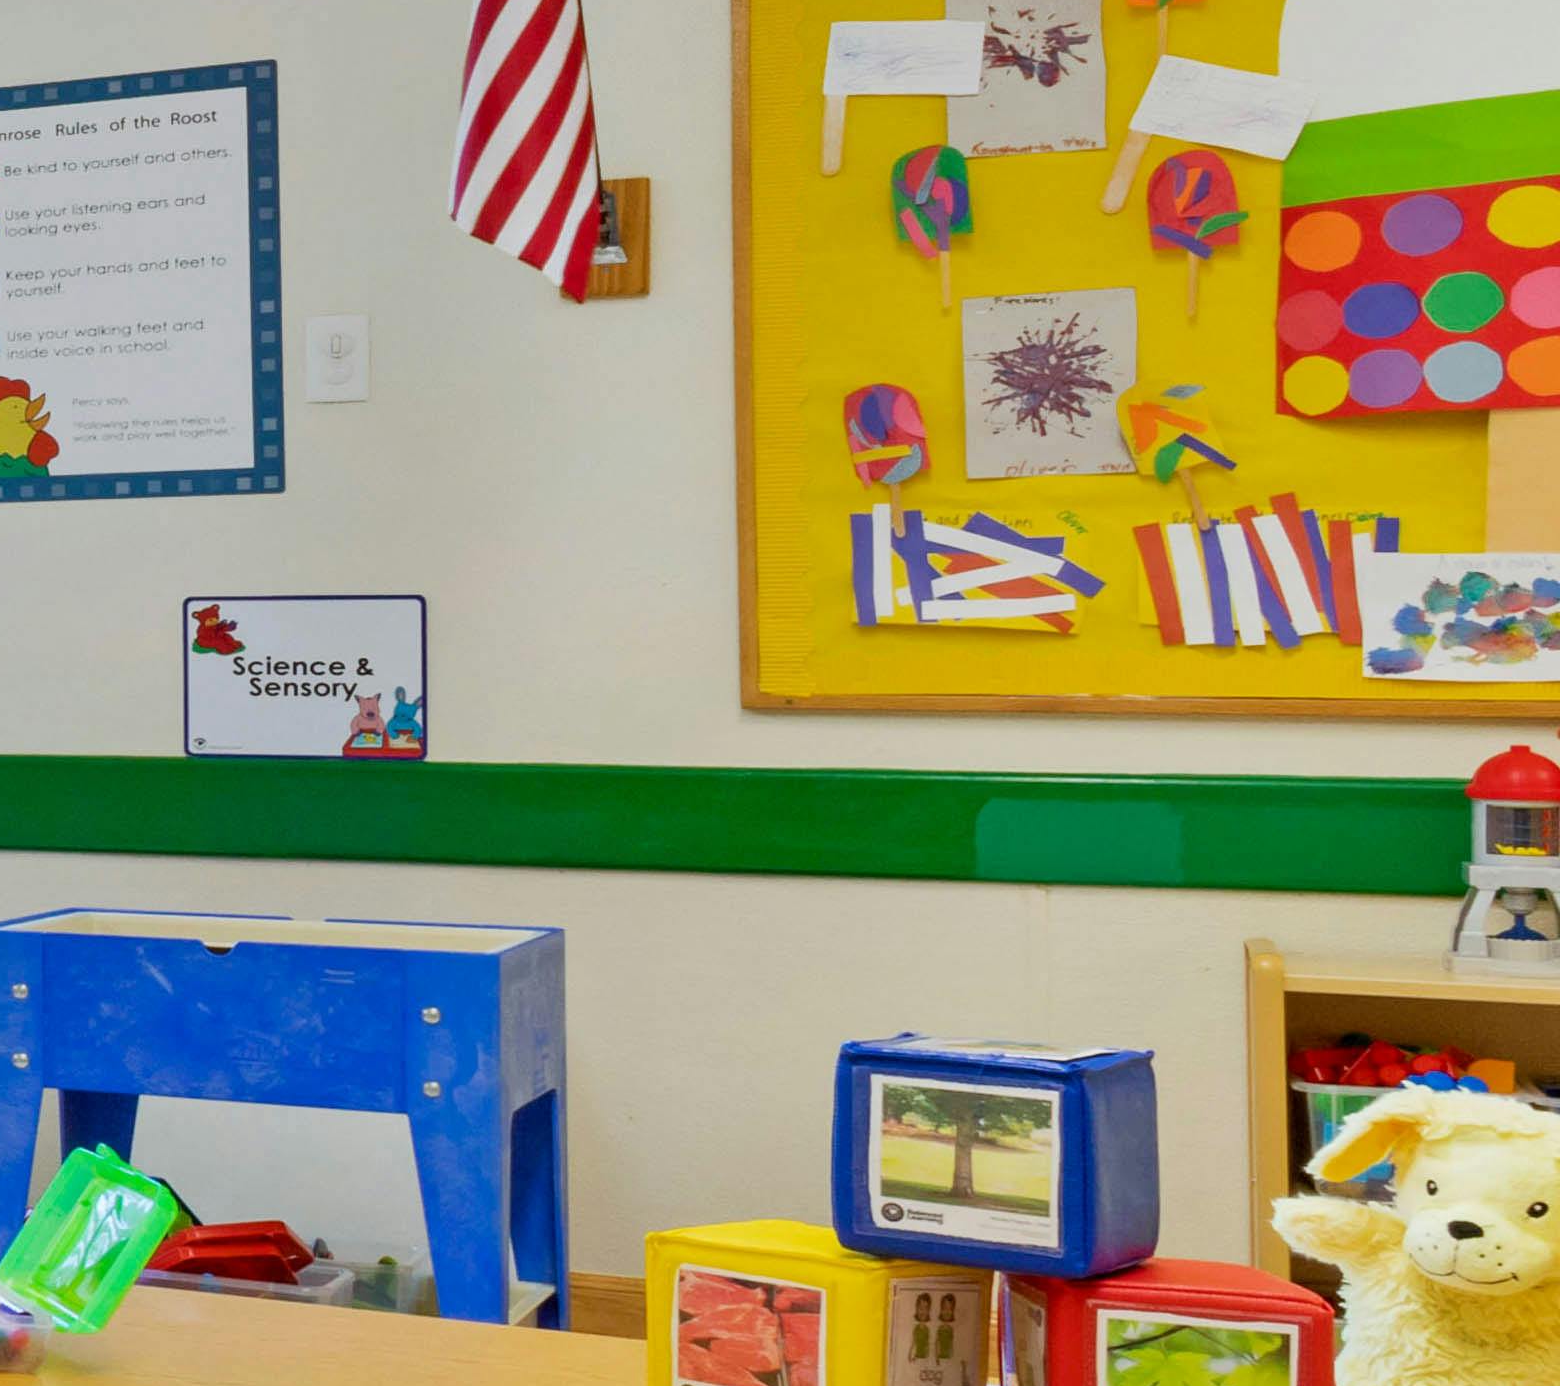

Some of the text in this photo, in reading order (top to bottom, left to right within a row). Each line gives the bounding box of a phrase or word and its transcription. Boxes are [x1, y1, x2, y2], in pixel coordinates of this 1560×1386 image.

[55, 119, 98, 137] Rules
[109, 117, 126, 132] of
[134, 113, 161, 129] the
[170, 109, 218, 127] Roost
[4, 146, 233, 178] Be kind to yourself and others.
[5, 193, 206, 222] Use your listening ears and
[5, 220, 102, 240] looking eyes.
[5, 254, 227, 286] Keep your hands and feet to
[6, 282, 65, 301] yourself.
[7, 317, 205, 343] Use your walking feet and
[6, 339, 171, 360] inside voice in school.
[233, 656, 374, 676] Science &
[249, 678, 358, 702] Sensory
[920, 1366, 944, 1386] dog
